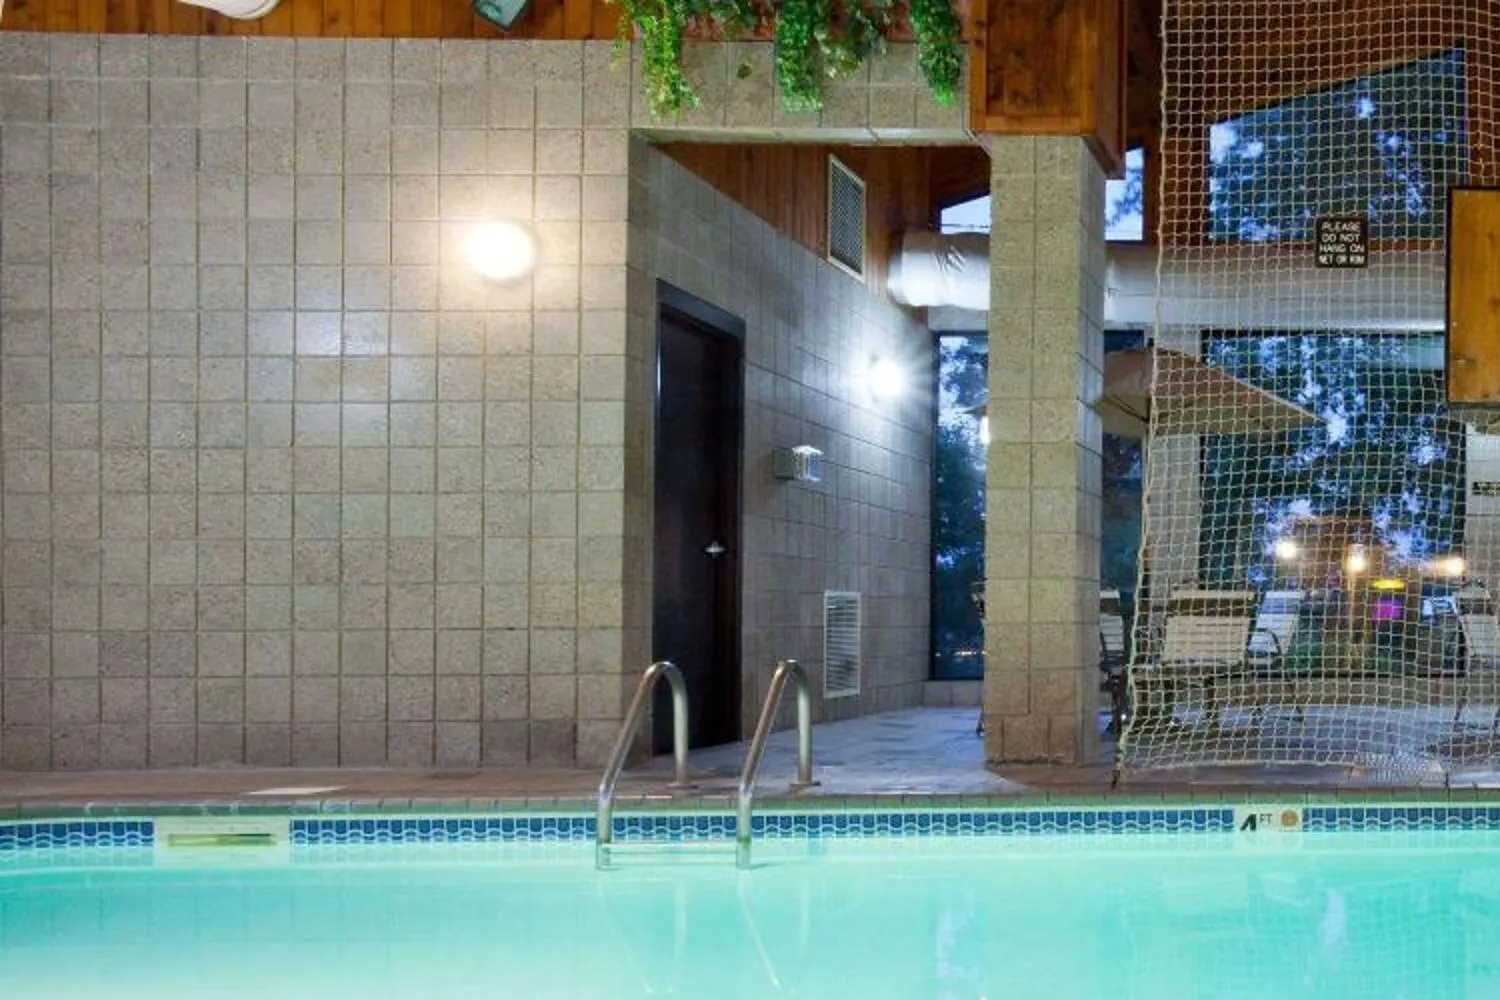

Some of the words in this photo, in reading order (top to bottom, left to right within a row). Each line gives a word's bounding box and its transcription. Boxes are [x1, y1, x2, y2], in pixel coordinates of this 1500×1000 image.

[1321, 221, 1361, 232] PLEASE
[1321, 233, 1337, 242] DO
[1339, 233, 1360, 242] NOT
[1319, 243, 1346, 253] HANG
[1349, 243, 1365, 253] ON
